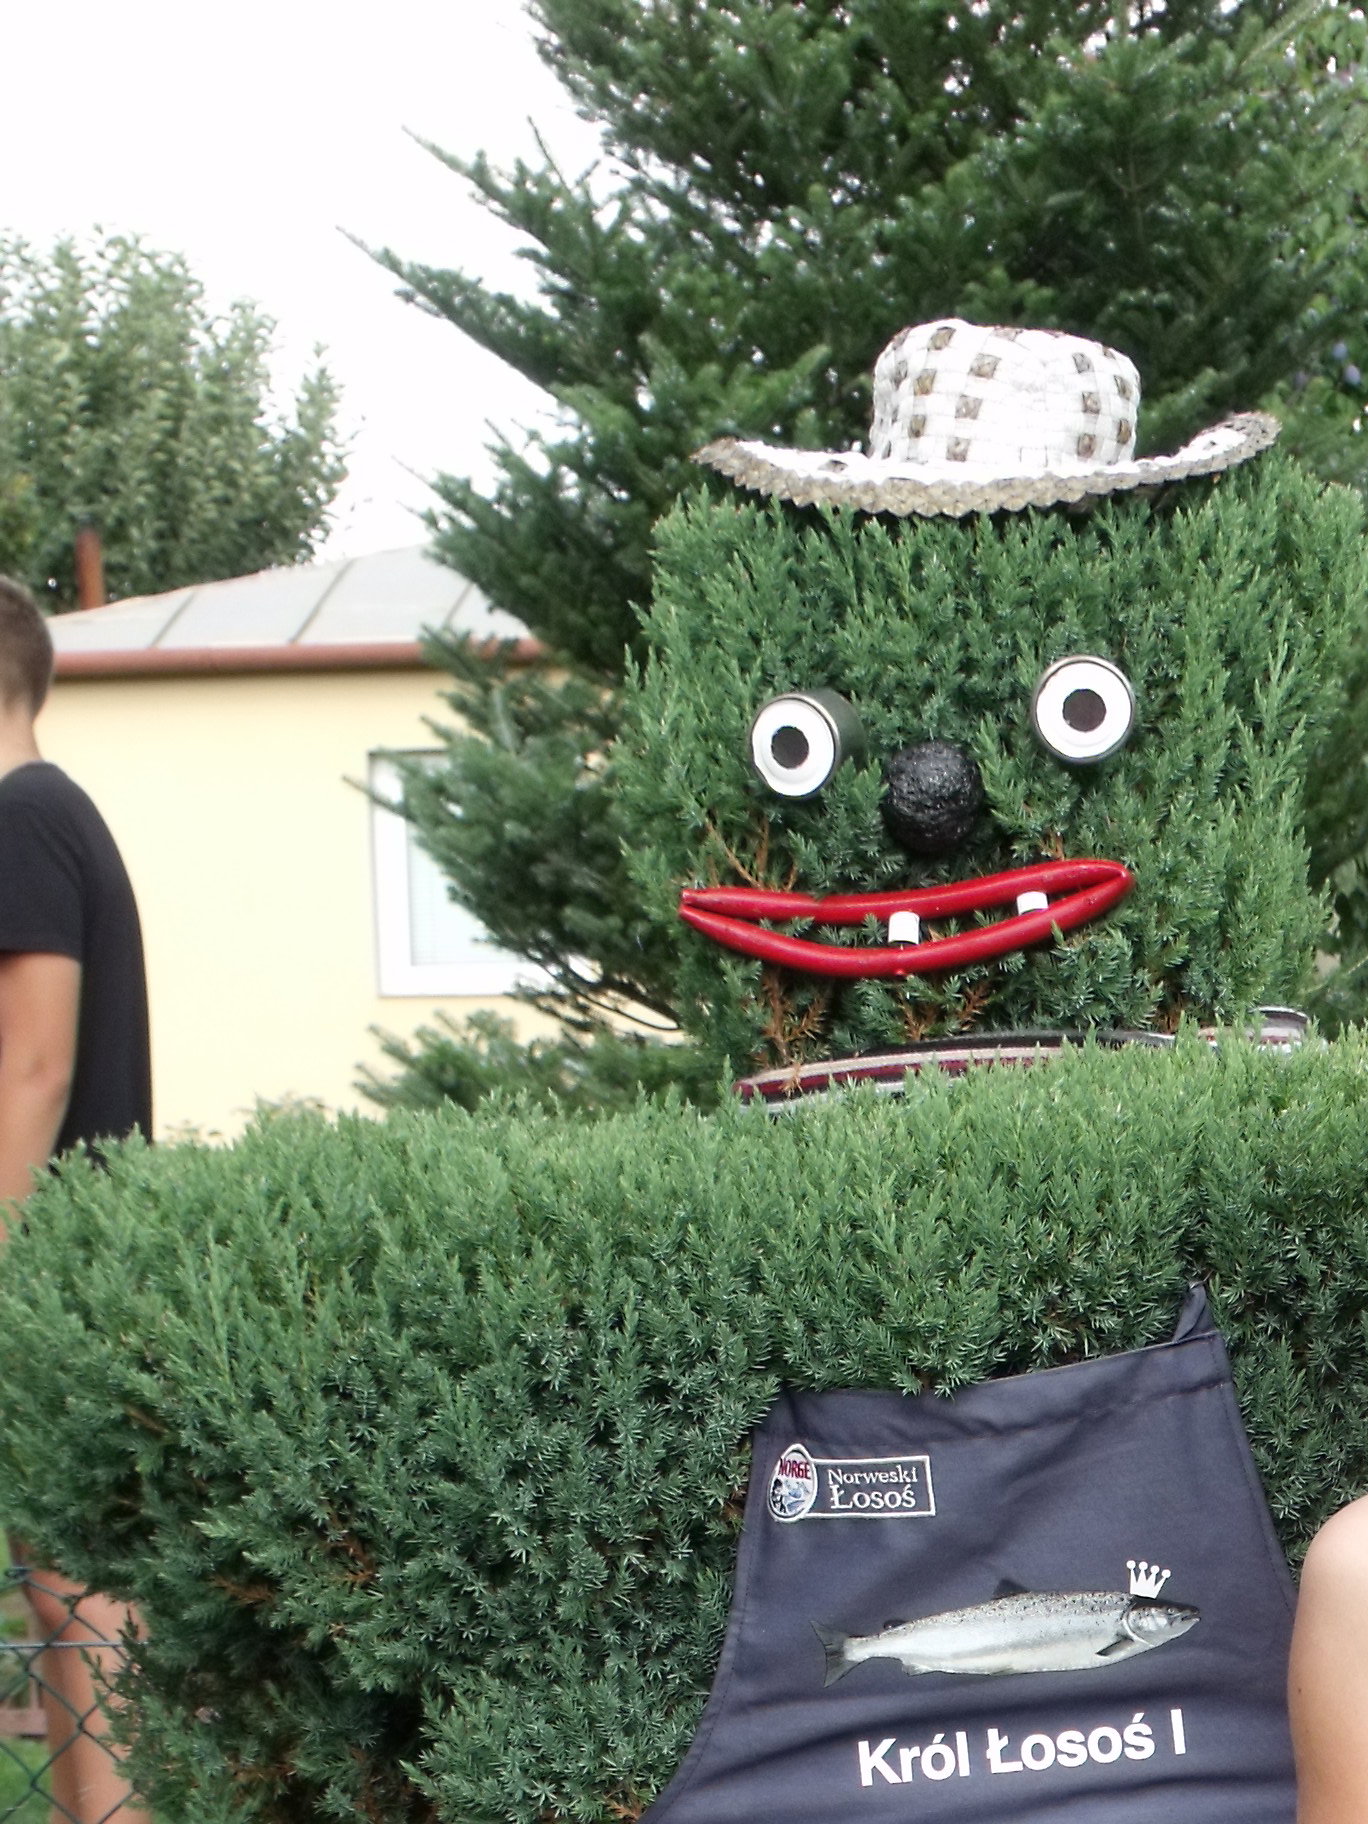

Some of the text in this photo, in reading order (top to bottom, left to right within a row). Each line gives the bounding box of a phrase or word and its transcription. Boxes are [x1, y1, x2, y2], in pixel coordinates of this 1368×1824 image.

[778, 1457, 811, 1480] NORGE
[828, 1465, 918, 1485] Norweski
[830, 1483, 917, 1509] Łosoś
[857, 1731, 971, 1787] Król
[986, 1712, 1156, 1774] Łosoś
